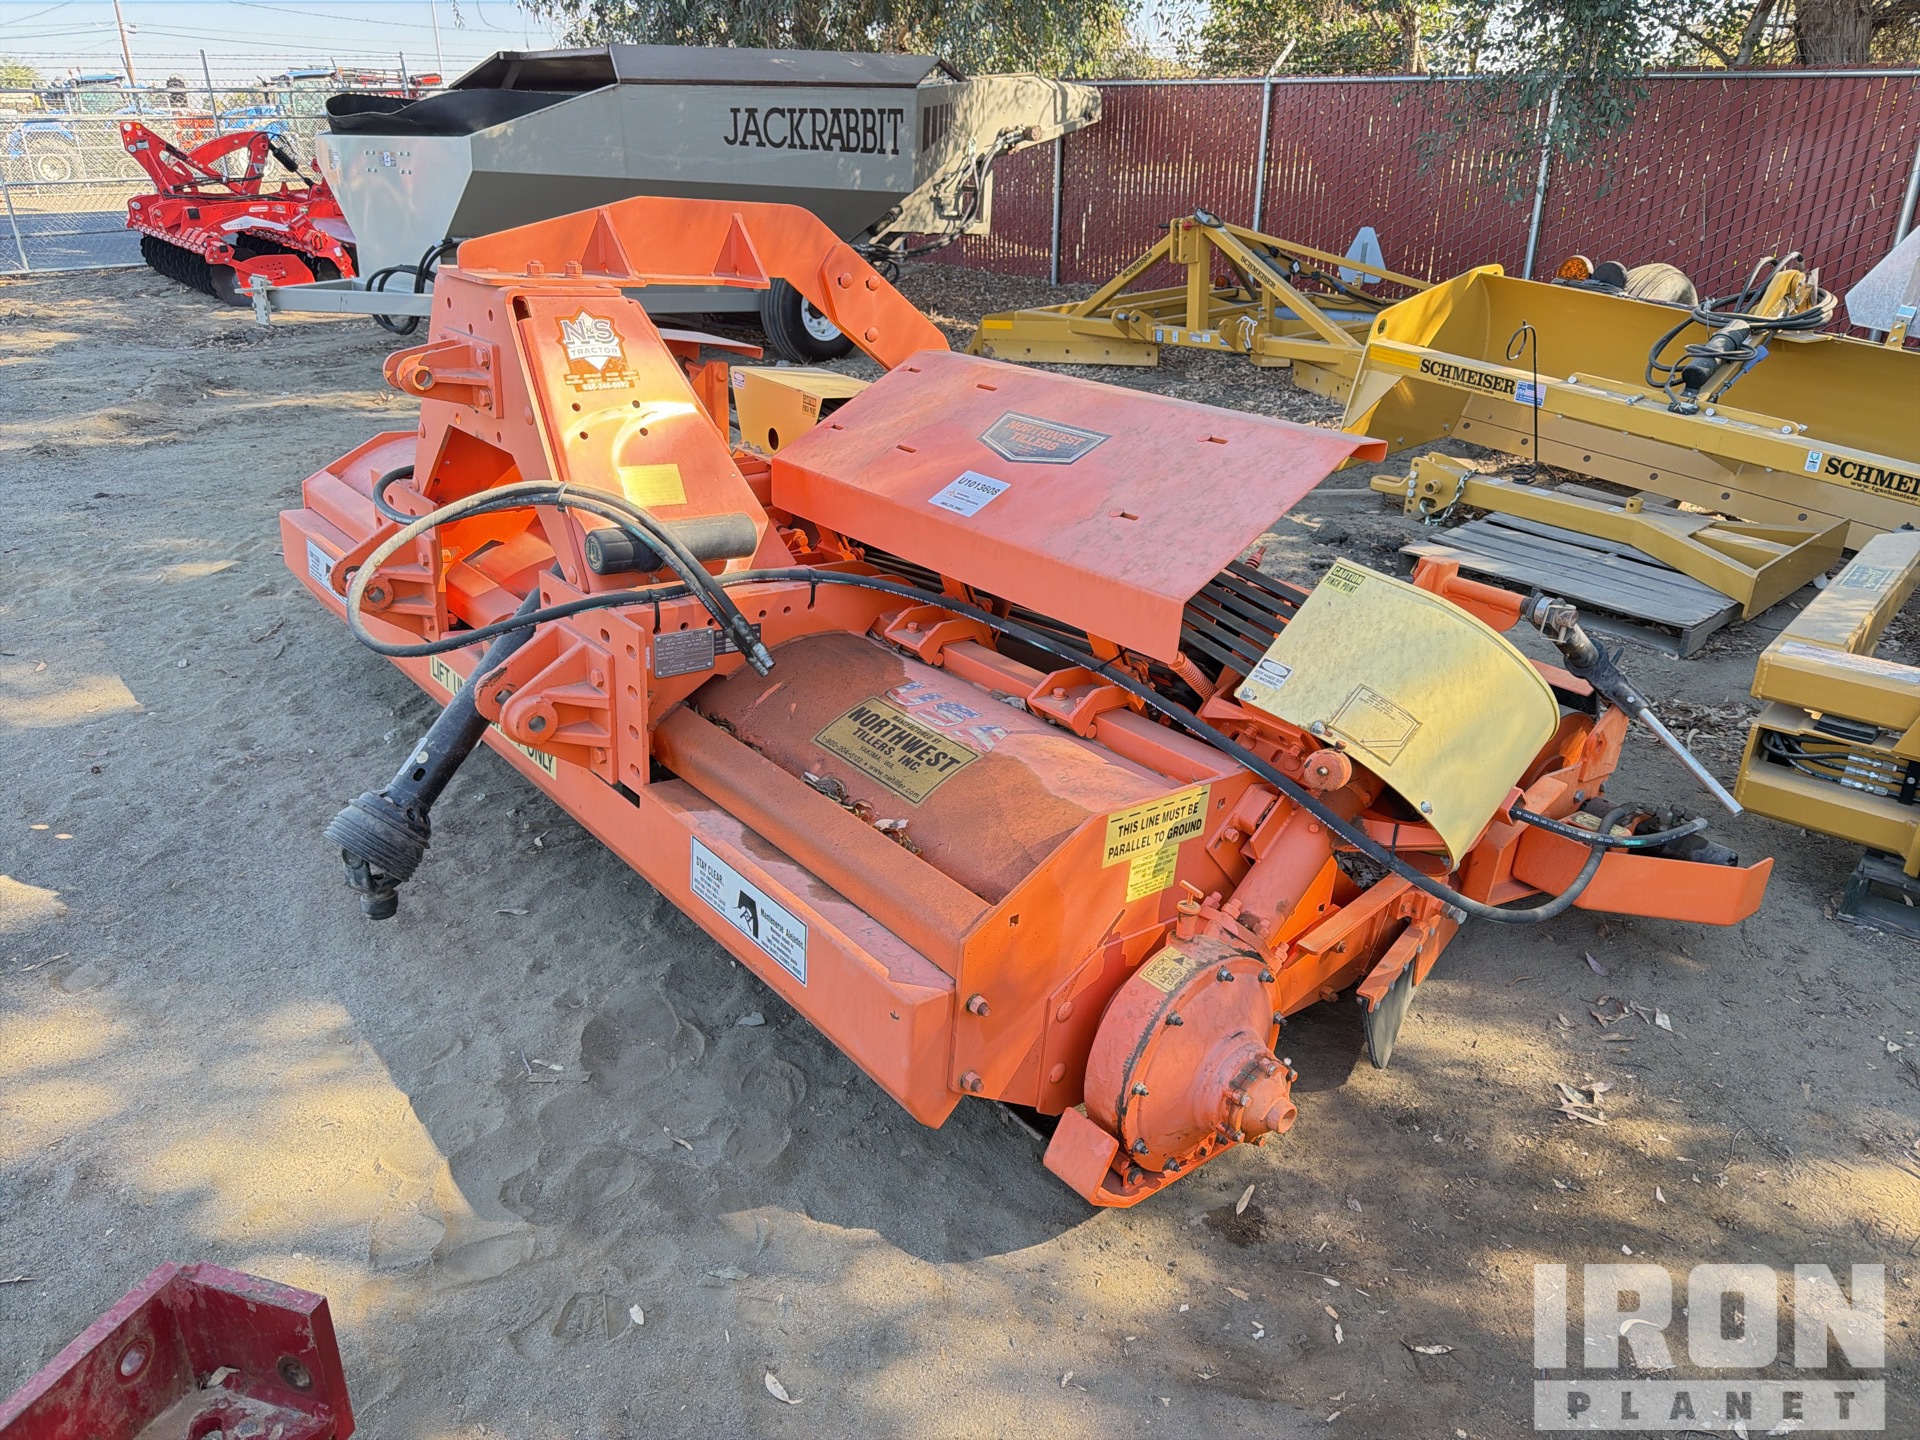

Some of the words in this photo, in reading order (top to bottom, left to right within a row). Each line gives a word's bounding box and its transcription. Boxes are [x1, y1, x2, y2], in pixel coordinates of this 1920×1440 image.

[723, 107, 904, 155] JACKRABBIT
[560, 319, 614, 344] N&S
[571, 347, 618, 357] TRACTOR
[1420, 358, 1515, 395] SCHMEISER
[1005, 420, 1086, 447] NORTHWEST
[1009, 431, 1060, 451] TILLERS
[958, 476, 1000, 496] U1013608
[1324, 575, 1342, 588] PINCH
[1340, 581, 1358, 594] POINT
[1333, 566, 1364, 584] CAUTION
[432, 657, 450, 687] LIFT
[885, 681, 1011, 753] USA
[891, 715, 935, 740] MANUFACTURED
[932, 735, 943, 745] BY
[847, 706, 961, 773] NORTHWEST
[852, 727, 894, 759] TILLERS,
[898, 755, 923, 774] INC.
[821, 735, 864, 767] 1-800-204-3122
[868, 764, 920, 799] www.nwtiller.com
[1118, 820, 1138, 838] THIS
[1140, 813, 1160, 831] LINE
[1161, 805, 1186, 824] MUST
[1187, 802, 1199, 814] BE
[1108, 834, 1151, 860] PARALLEL
[1154, 830, 1165, 843] TO
[1167, 818, 1202, 840] GROUND
[696, 856, 707, 872] STAY
[1146, 957, 1166, 977] CHECK
[1158, 966, 1170, 975] OIL
[1159, 967, 1179, 984] LEVEL
